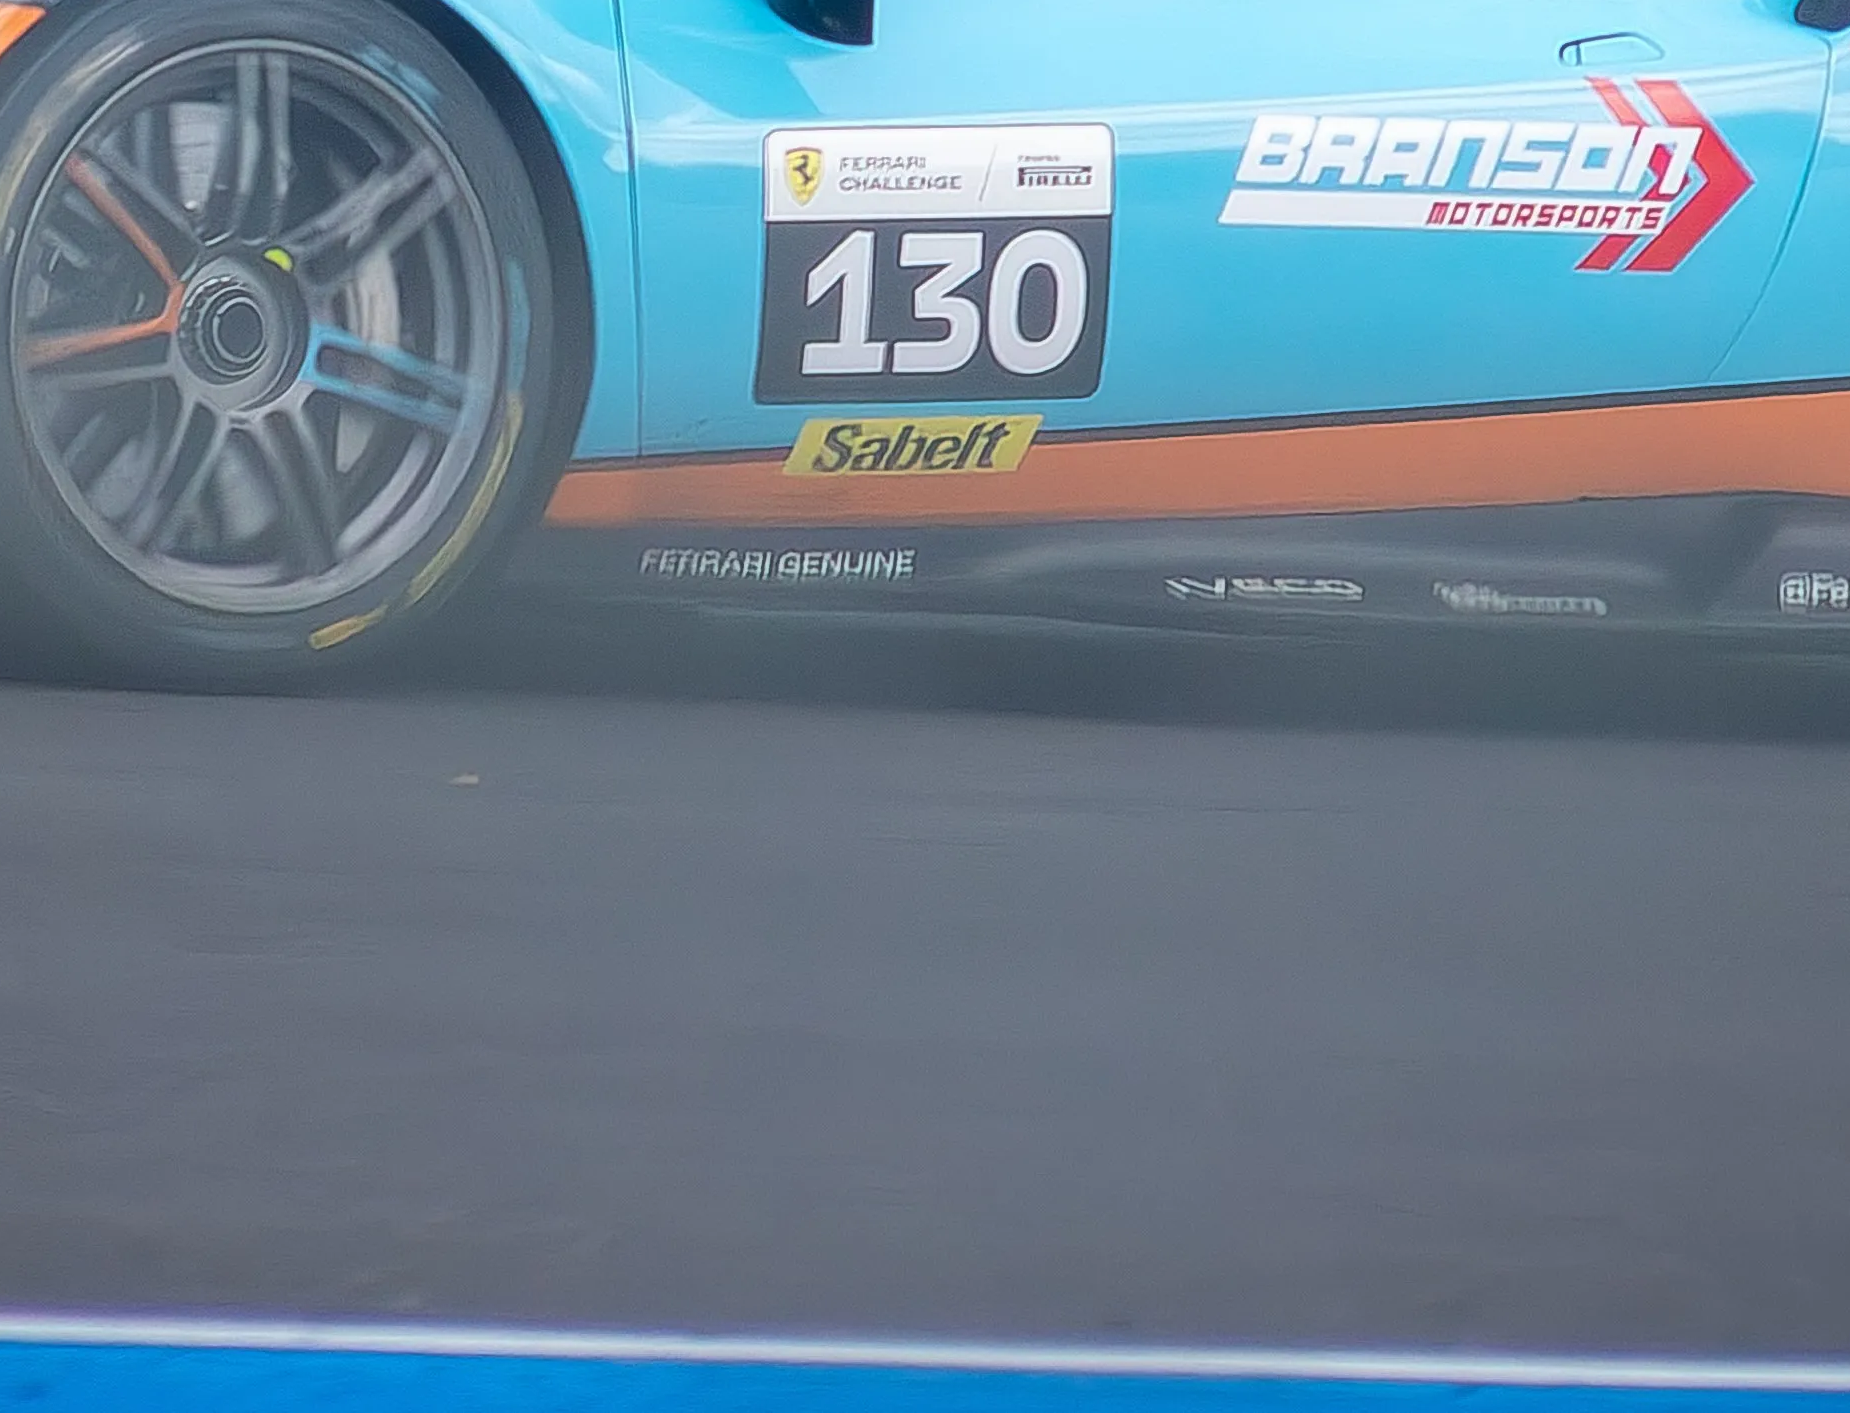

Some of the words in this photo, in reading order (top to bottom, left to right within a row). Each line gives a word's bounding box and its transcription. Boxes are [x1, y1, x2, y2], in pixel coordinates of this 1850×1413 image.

[1235, 113, 1702, 195] BRANSON
[839, 174, 962, 191] CHALLENGE
[1425, 201, 1665, 229] MOTORSPORTS
[801, 229, 1088, 377] 130
[811, 420, 1011, 473] Sabelt
[777, 549, 916, 582] GENUINE
